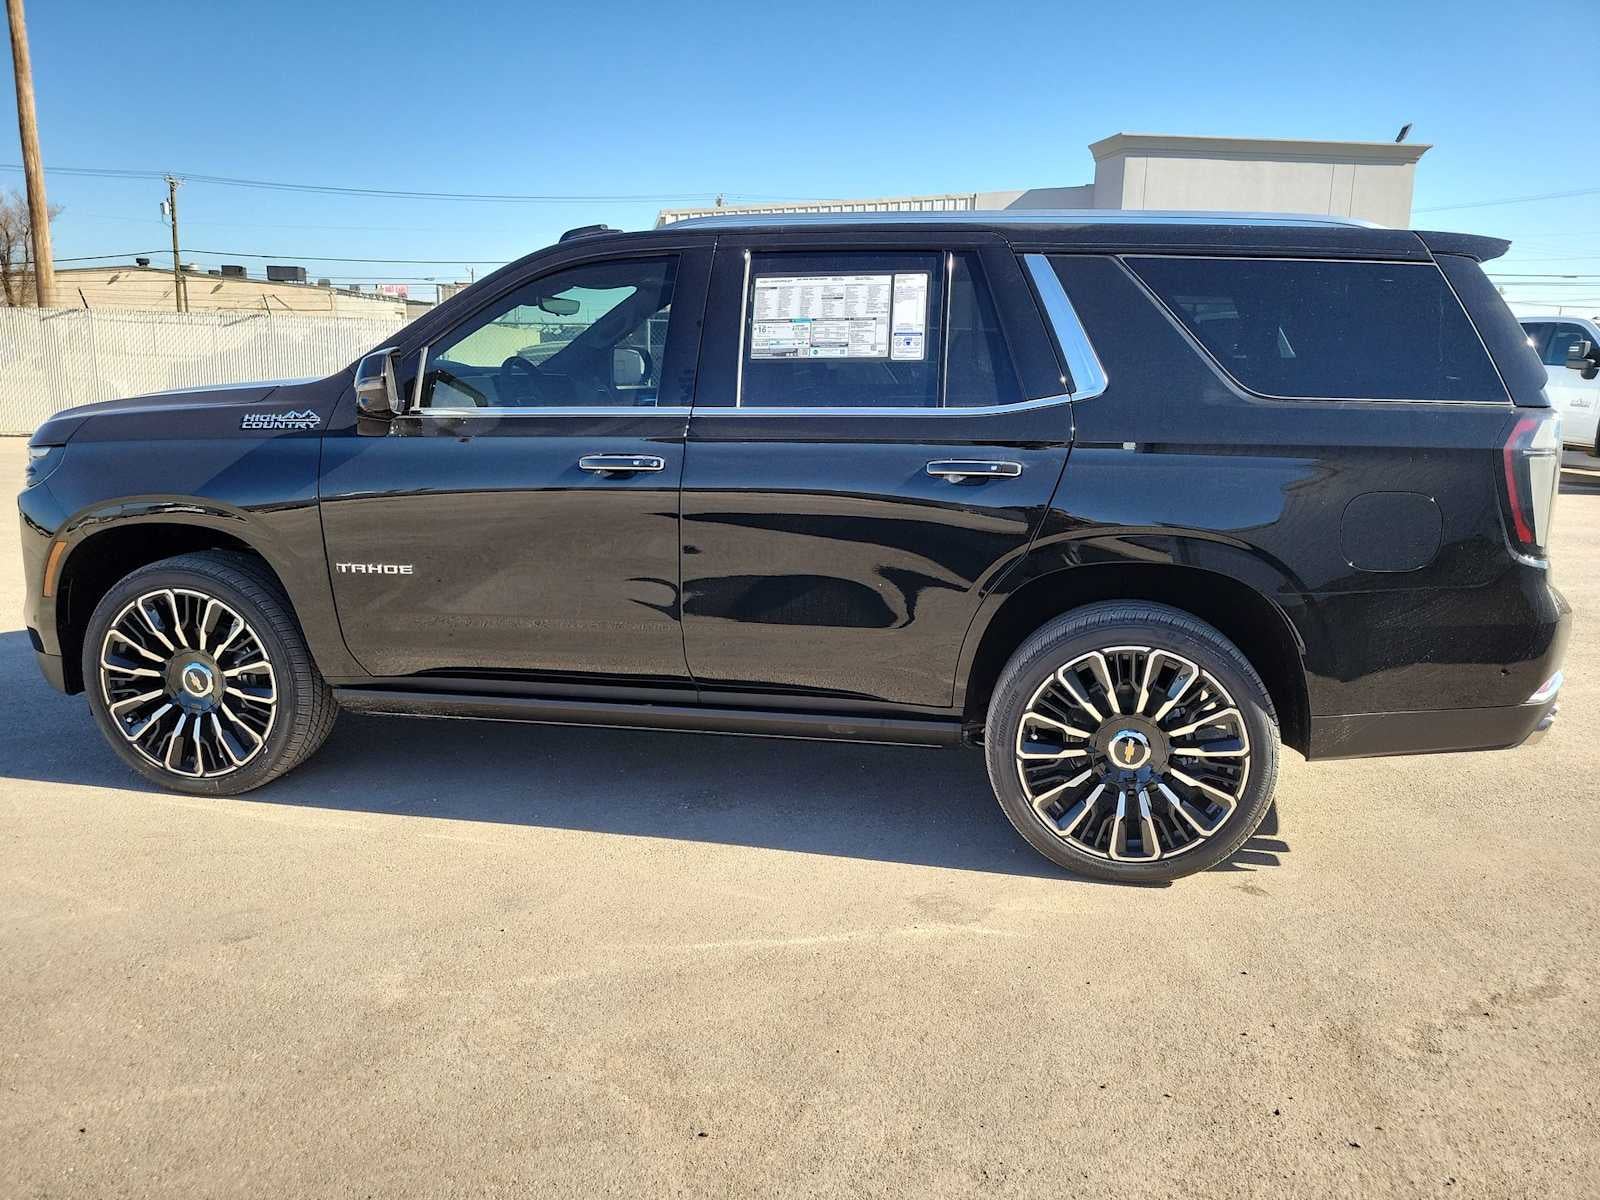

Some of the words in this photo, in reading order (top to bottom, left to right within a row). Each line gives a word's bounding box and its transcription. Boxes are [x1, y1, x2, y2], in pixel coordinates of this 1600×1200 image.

[243, 414, 283, 422] HIGH
[241, 421, 320, 429] COUNTRY
[335, 562, 413, 575] TAHOE
